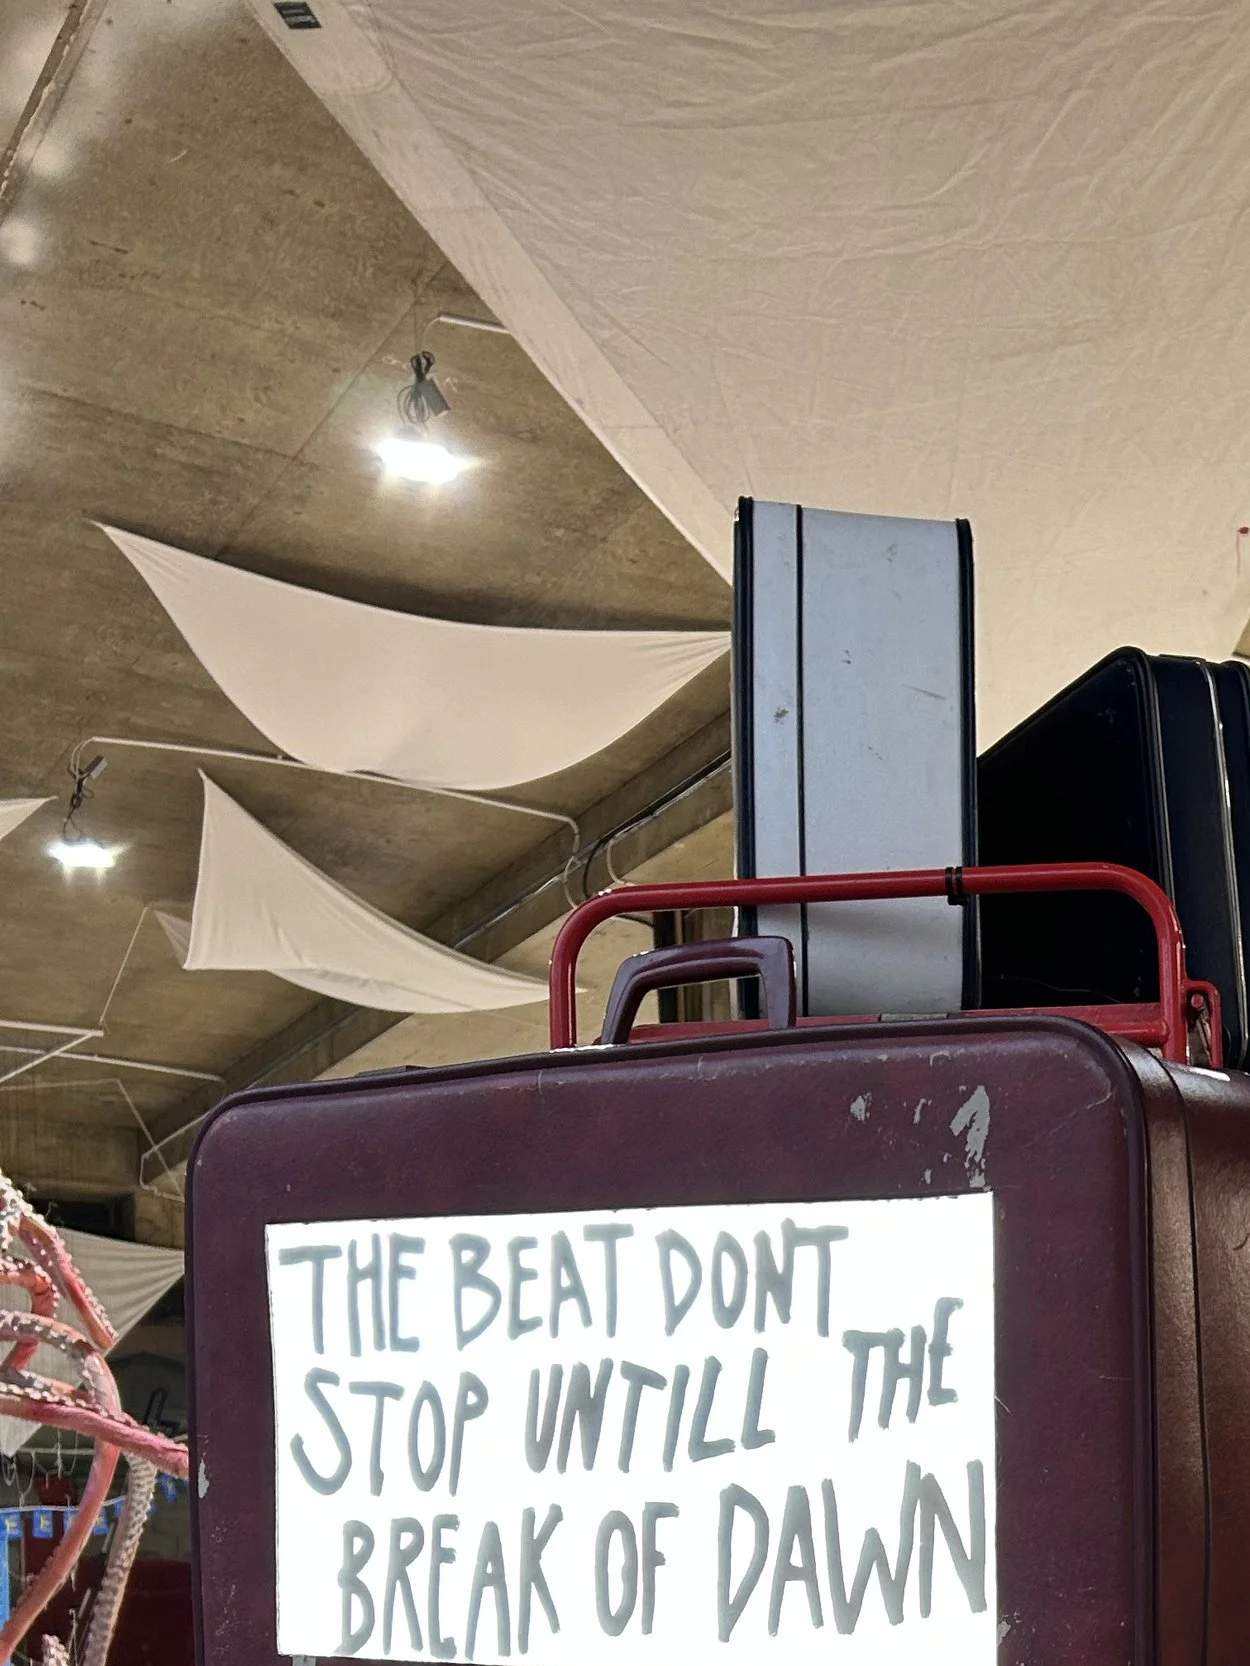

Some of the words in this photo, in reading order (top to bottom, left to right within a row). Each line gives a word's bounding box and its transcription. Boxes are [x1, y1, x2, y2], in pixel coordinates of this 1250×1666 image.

[278, 1232, 425, 1356] THE
[447, 1222, 636, 1352] BEAT
[654, 1216, 851, 1340] DONT
[288, 1366, 490, 1498] STOP
[522, 1346, 778, 1476] UNTILL
[840, 1296, 965, 1445] THE
[332, 1502, 564, 1662] BREAK
[593, 1500, 682, 1638] OF
[716, 1458, 989, 1644] DAWN
